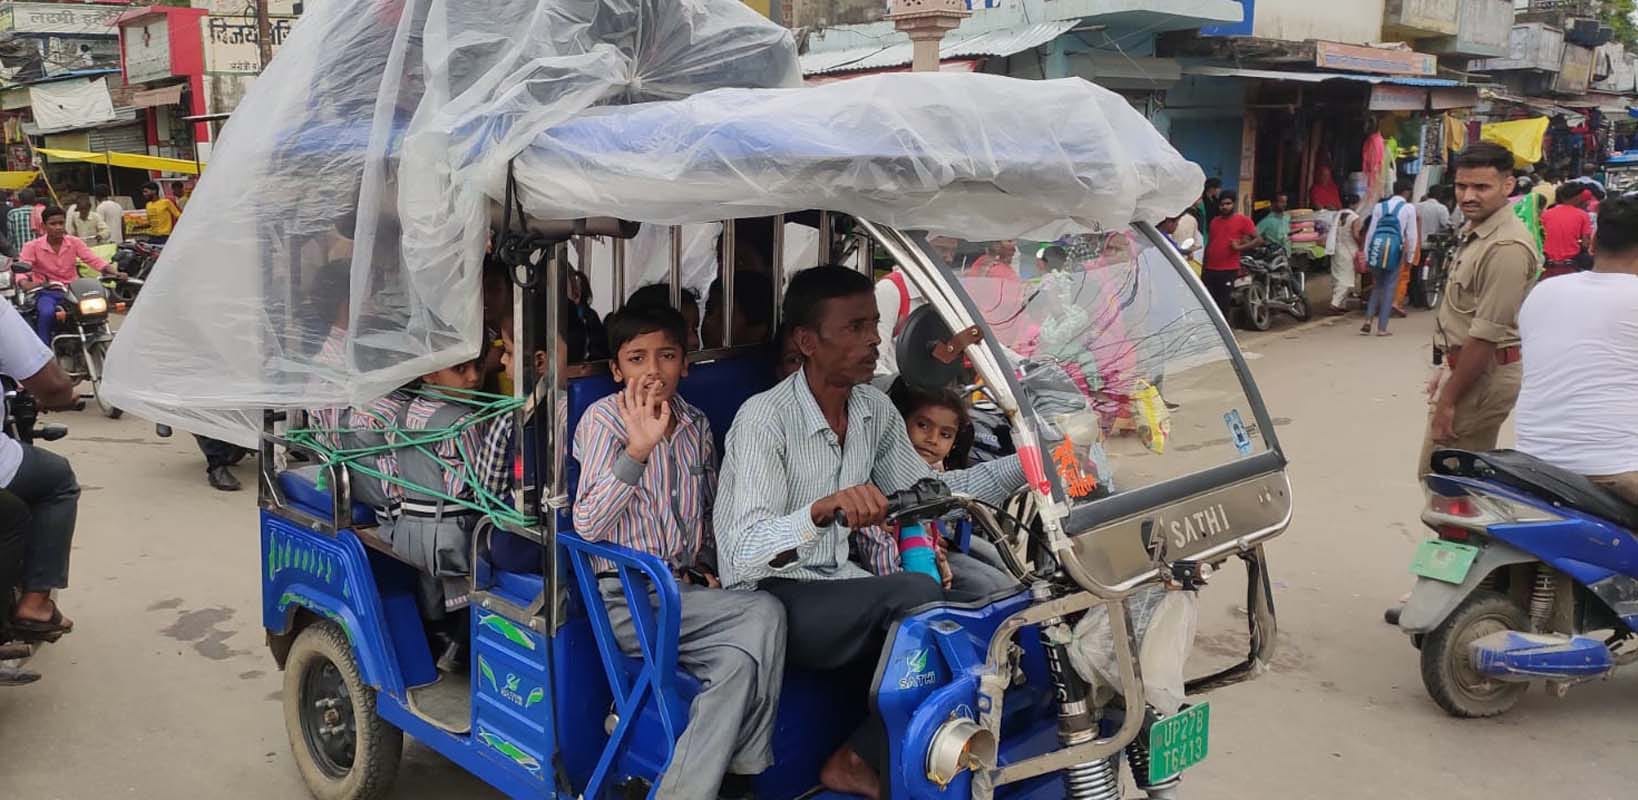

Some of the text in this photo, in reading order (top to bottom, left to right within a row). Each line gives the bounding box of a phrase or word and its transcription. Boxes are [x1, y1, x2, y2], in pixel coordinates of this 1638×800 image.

[1170, 504, 1230, 549] SATHI
[899, 671, 936, 689] SATHI
[1163, 736, 1203, 777] T6413
